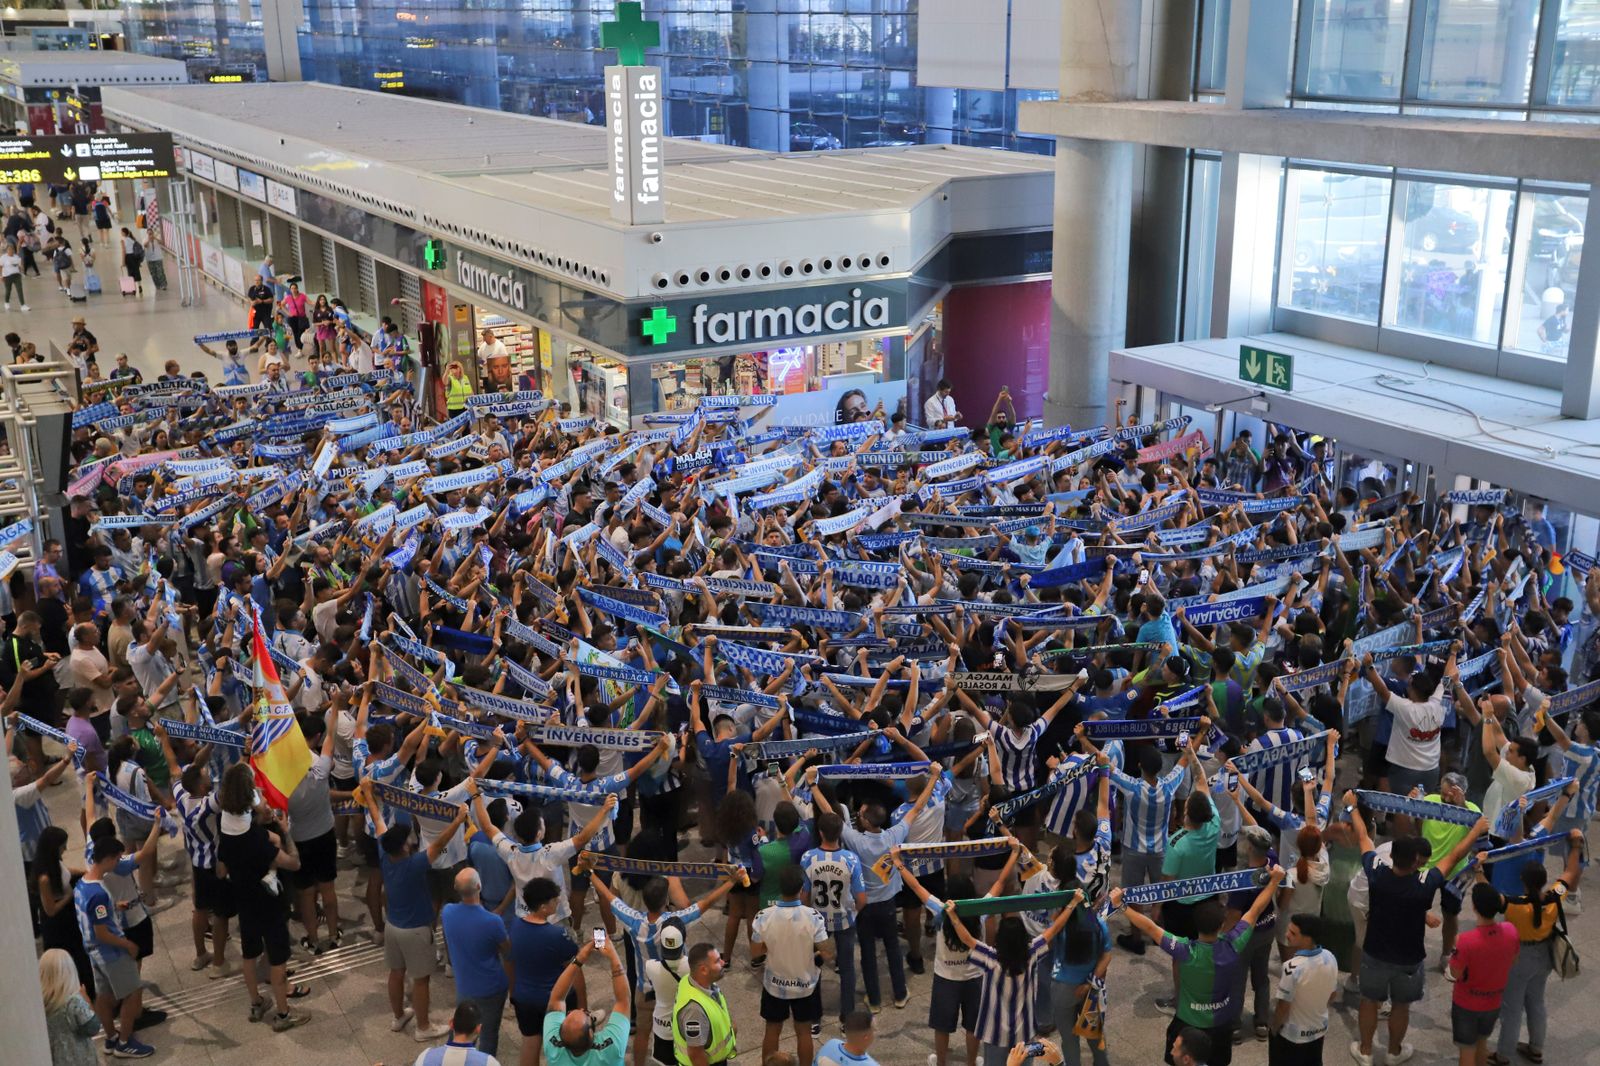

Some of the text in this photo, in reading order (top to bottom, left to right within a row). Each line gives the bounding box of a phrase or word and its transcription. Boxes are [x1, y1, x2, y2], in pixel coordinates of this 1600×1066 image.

[610, 74, 625, 202] farmacia
[634, 74, 659, 204] farmacia
[456, 251, 527, 310] farmacia
[693, 288, 890, 345] farmacia
[371, 369, 392, 380] SUR
[752, 395, 775, 405] SUR
[825, 425, 867, 438] MALAGA
[1166, 416, 1190, 431] SUR
[675, 449, 713, 465] MALAGA
[1092, 442, 1113, 456] SUR
[861, 453, 904, 464] FONDO
[930, 456, 974, 474] INVENCIBLES
[433, 472, 487, 489] INVENCIBLES
[1449, 491, 1503, 502] MALAGA
[706, 577, 772, 593] INVENCIBLES
[899, 624, 921, 636] SU
[609, 670, 650, 683] MALAGA
[467, 690, 539, 718] INVENCIBLES
[199, 731, 236, 744] MALAGA
[546, 728, 640, 747] INVENCIBLES
[814, 865, 843, 878] AMORES
[812, 879, 844, 909] 33
[1161, 888, 1176, 898] DE
[1181, 878, 1239, 896] MALAGA
